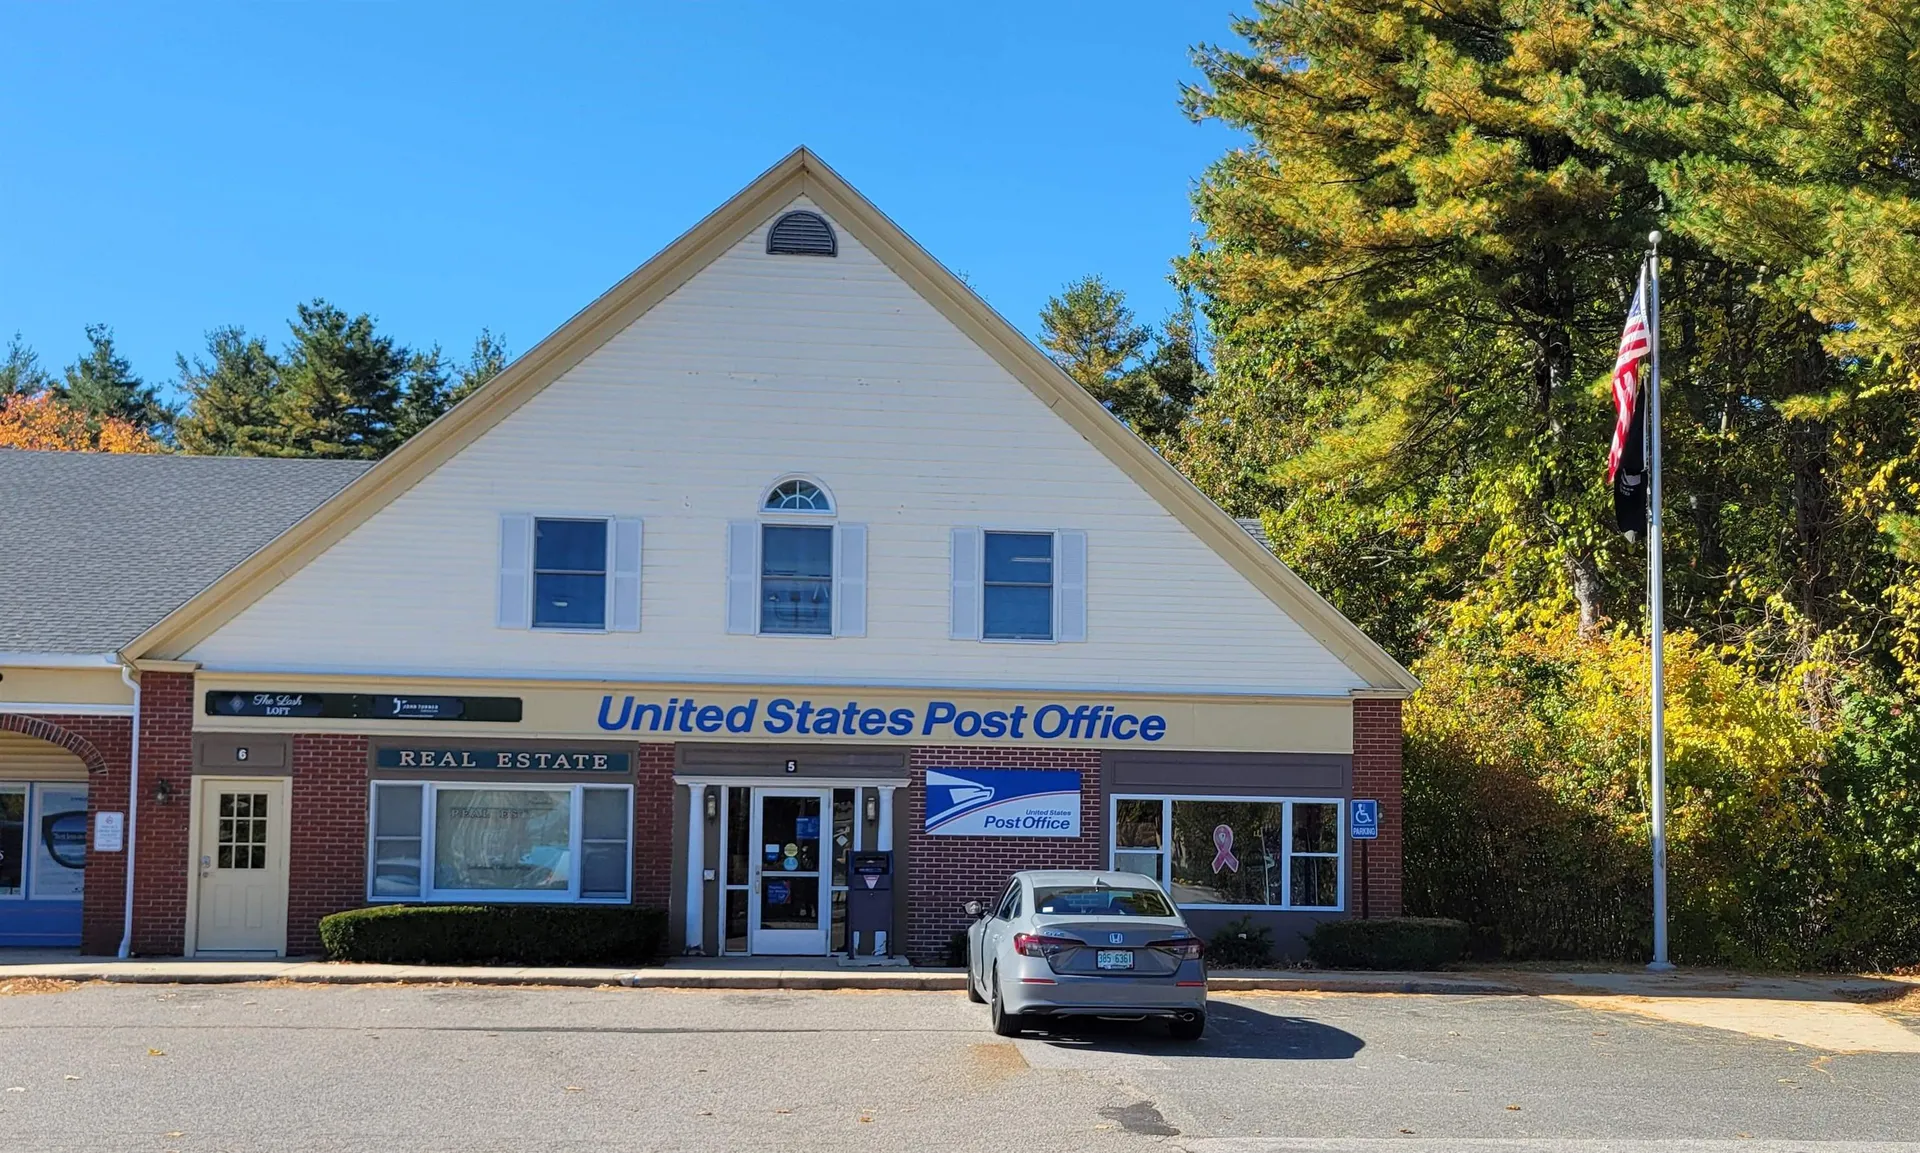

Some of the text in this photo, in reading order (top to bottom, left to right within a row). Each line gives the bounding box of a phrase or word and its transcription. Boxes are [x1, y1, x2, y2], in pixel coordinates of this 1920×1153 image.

[253, 694, 302, 706] The Lash
[266, 706, 290, 715] LOFT
[598, 696, 1166, 741] United States Post Office
[239, 749, 247, 760] 6
[400, 751, 608, 770] REAL ESTATE
[787, 761, 796, 772] 5
[984, 816, 1070, 830] Post Office
[1353, 827, 1375, 836] PARKING
[1098, 953, 1112, 963] 385
